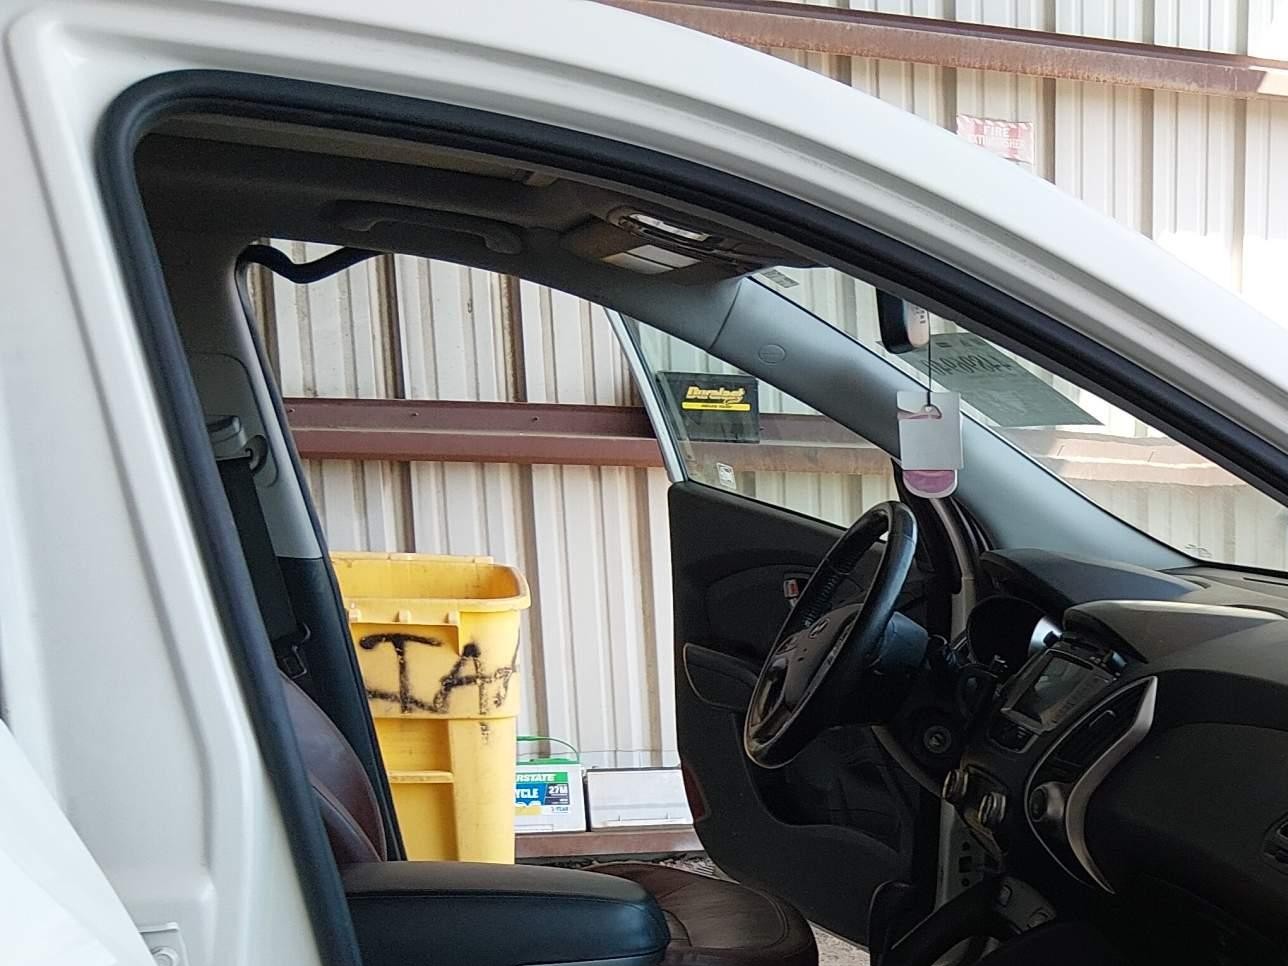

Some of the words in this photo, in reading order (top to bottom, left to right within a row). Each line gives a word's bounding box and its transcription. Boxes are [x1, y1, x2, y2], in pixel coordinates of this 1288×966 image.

[984, 125, 1009, 137] FIRE
[515, 774, 556, 782] RSTATE
[514, 788, 539, 799] YCLE
[548, 784, 568, 794] 27M
